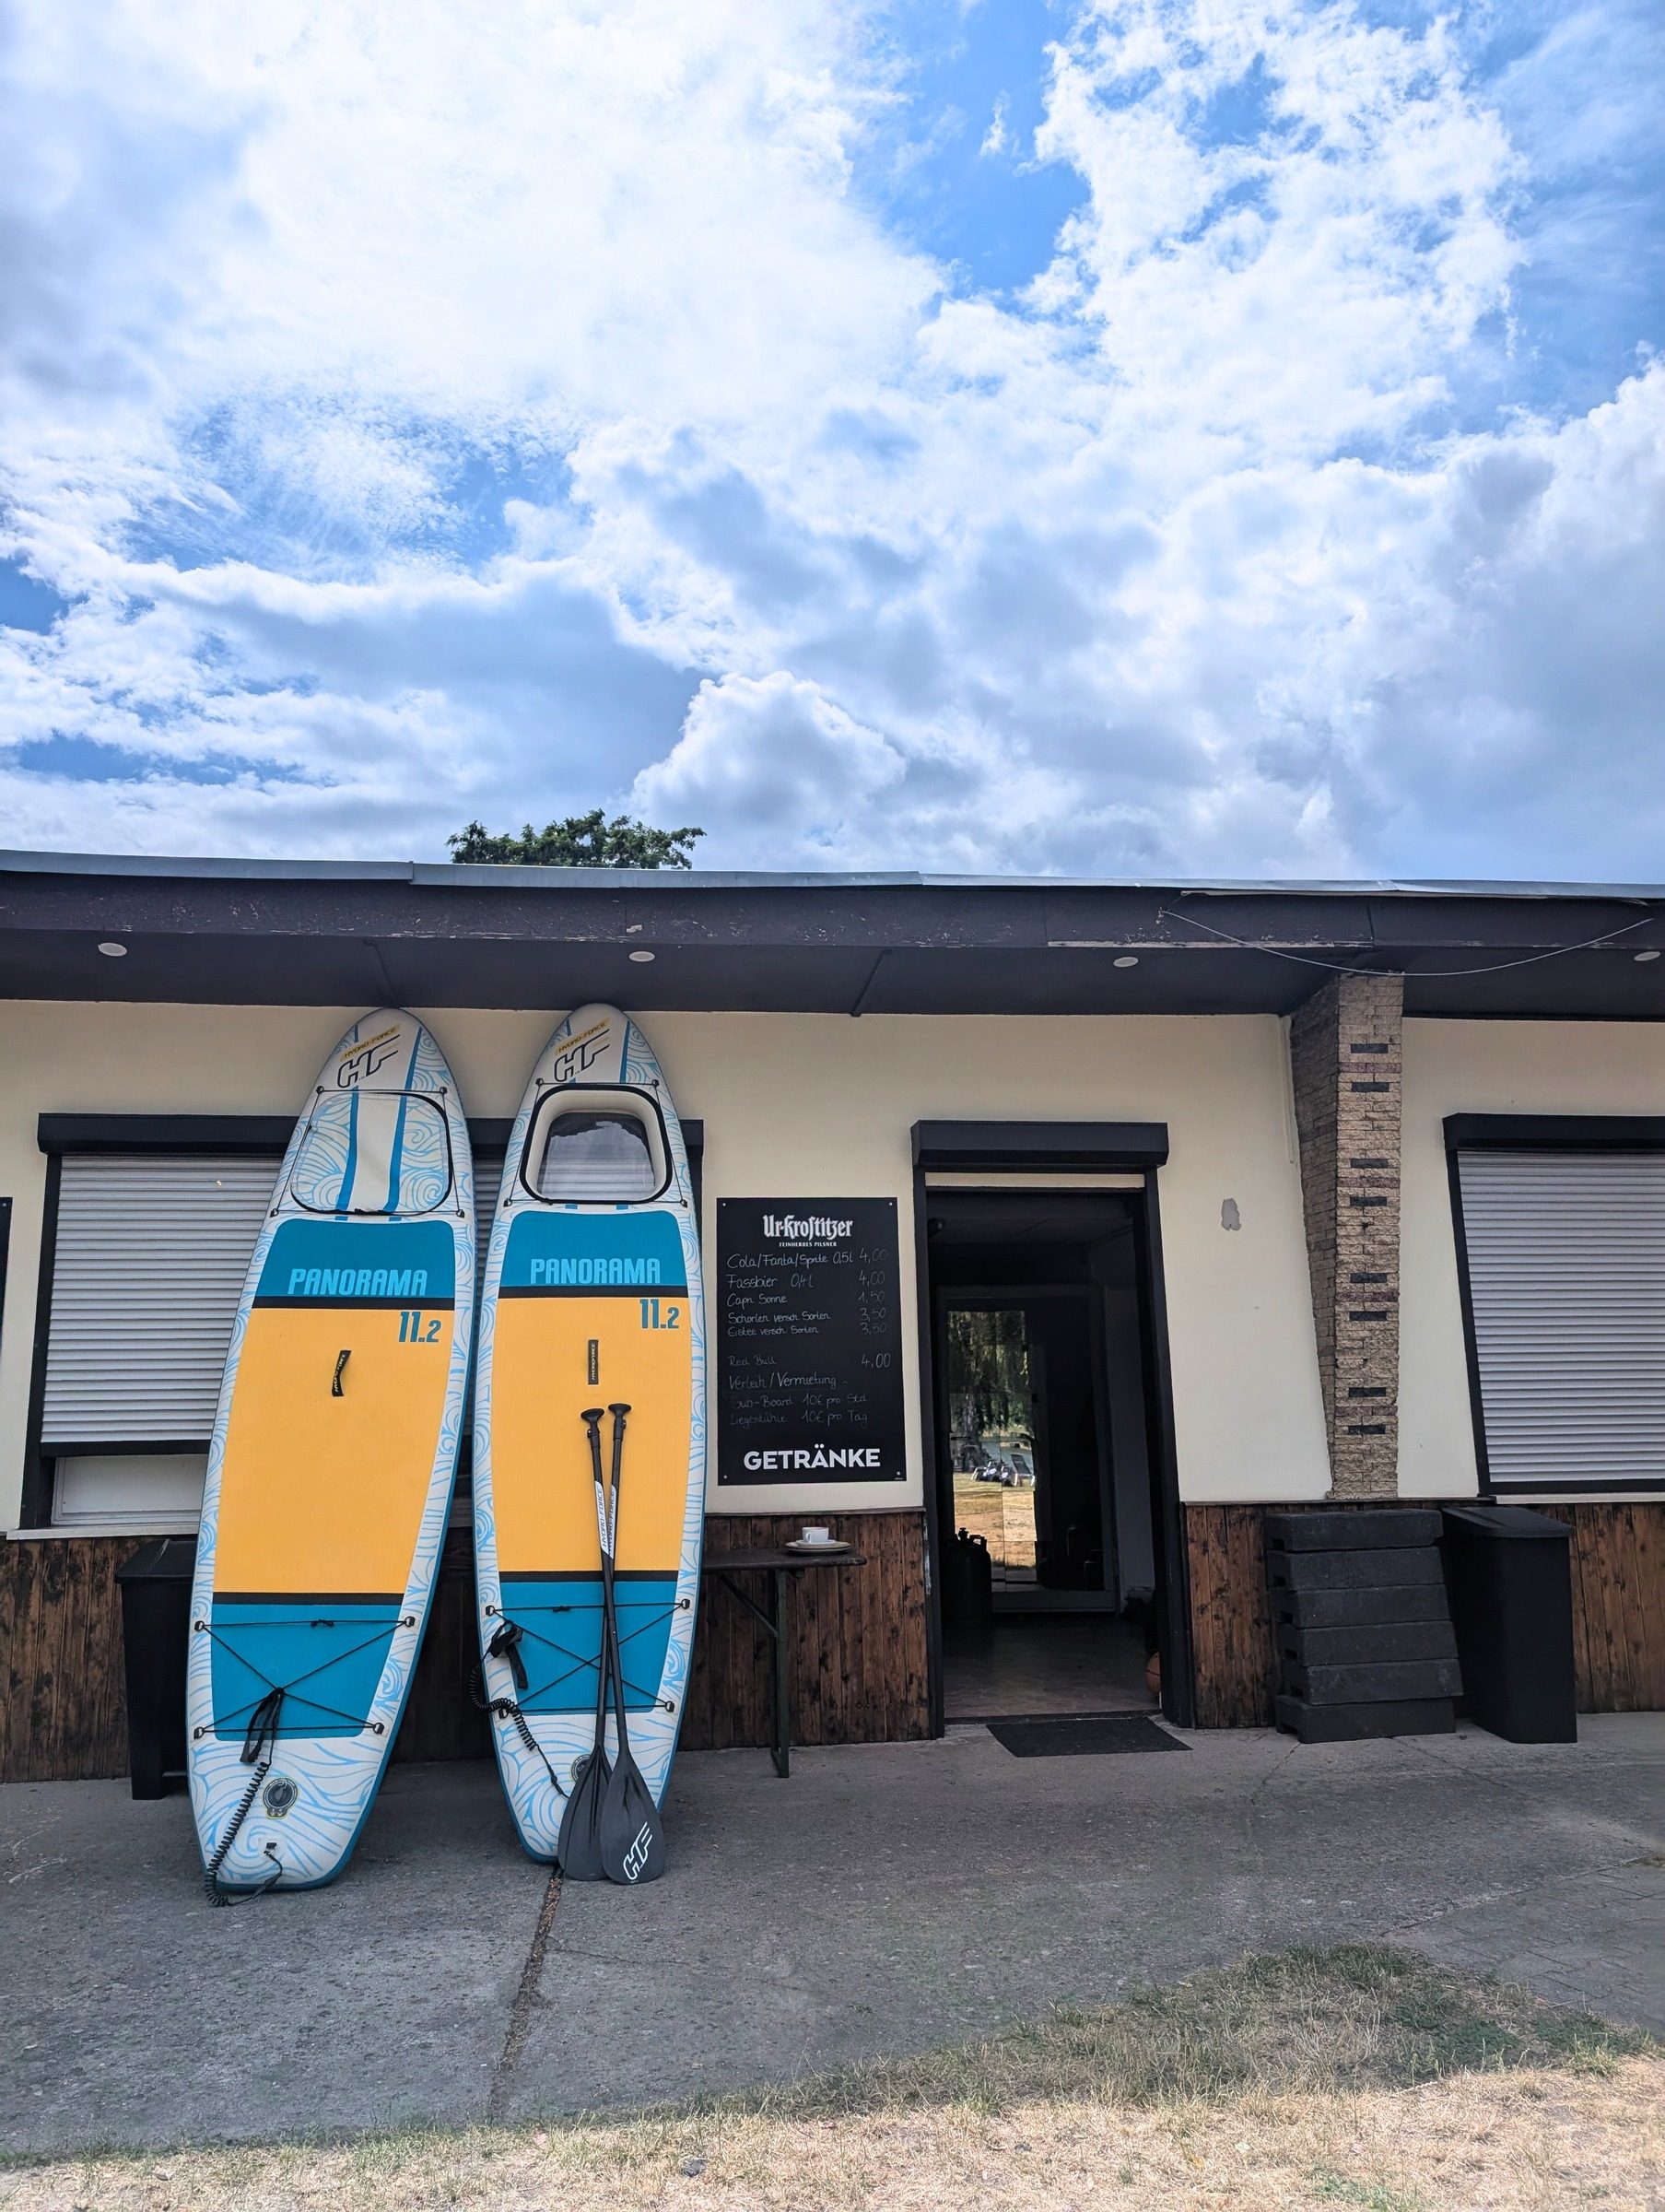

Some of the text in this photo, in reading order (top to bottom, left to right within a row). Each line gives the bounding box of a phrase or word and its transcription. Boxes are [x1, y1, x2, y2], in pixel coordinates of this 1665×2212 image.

[530, 1258, 661, 1284] PANORAMA
[726, 1274, 777, 1288] Fassbier
[287, 1268, 428, 1296] PANORAMA
[758, 1293, 787, 1305] Sonne
[639, 1299, 680, 1329] 11.2
[802, 1311, 830, 1321] Sorten
[398, 1312, 441, 1343] 11.2
[791, 1324, 819, 1335] Sorten
[728, 1356, 750, 1366] Red
[755, 1355, 777, 1365] Bull
[848, 1409, 868, 1429] Tag
[744, 1443, 881, 1471] GETRÄNKE
